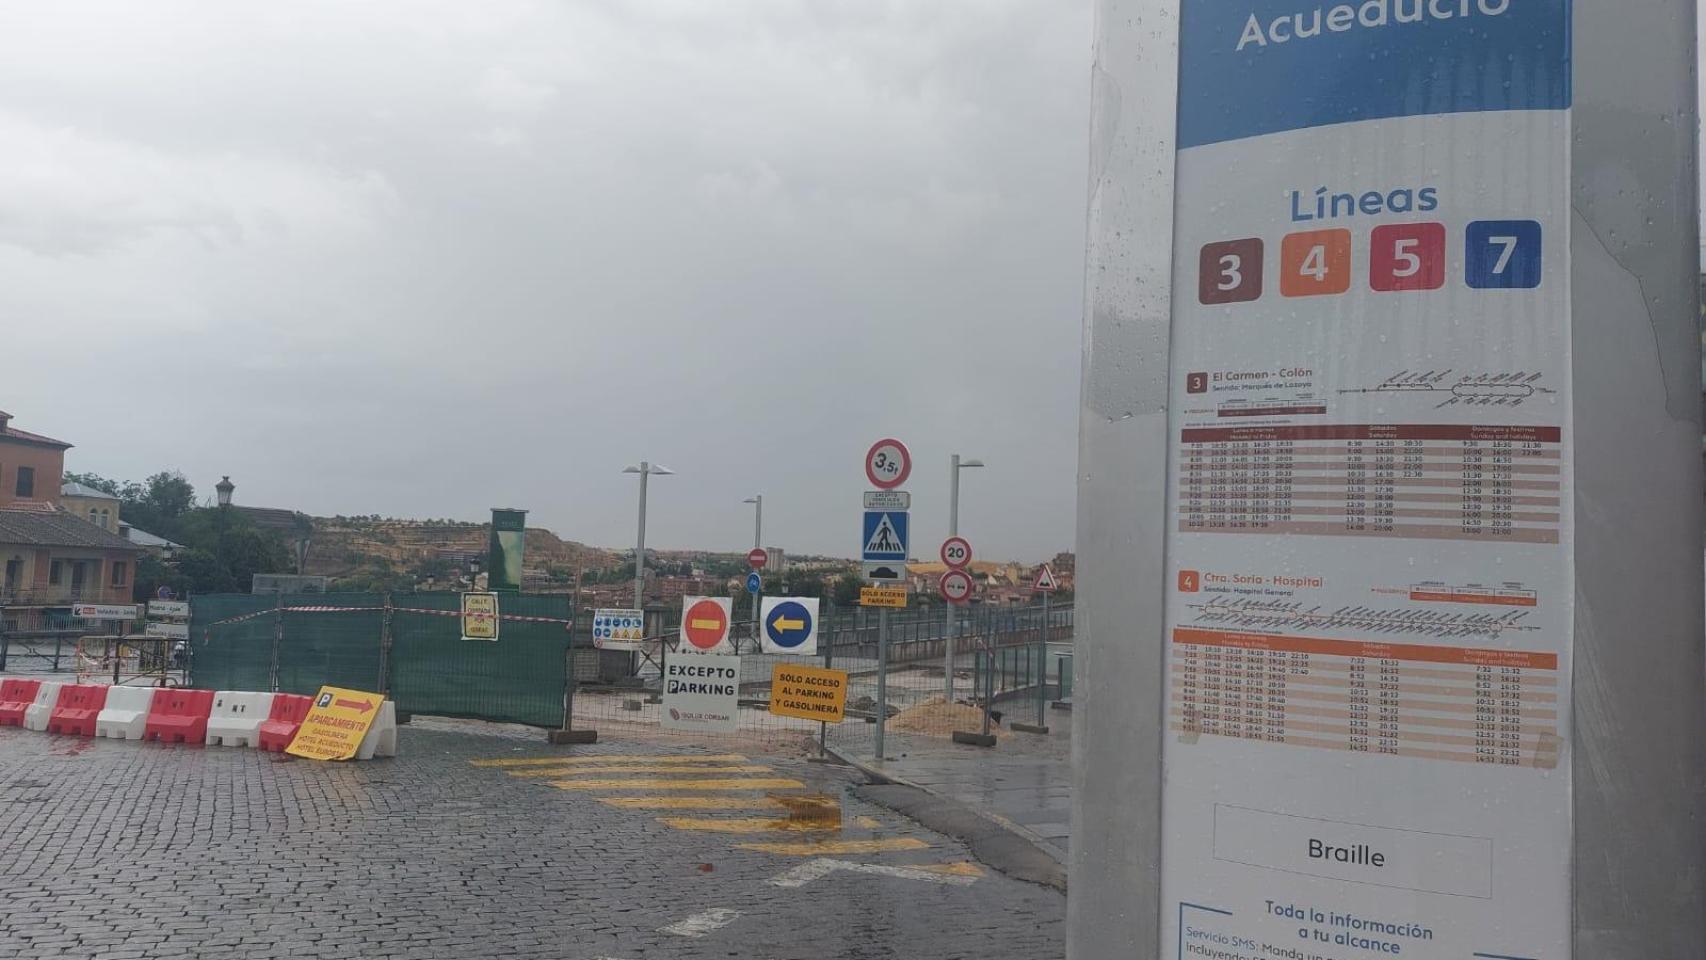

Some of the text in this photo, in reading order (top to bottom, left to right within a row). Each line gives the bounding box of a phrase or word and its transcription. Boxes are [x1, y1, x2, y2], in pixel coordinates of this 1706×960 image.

[1290, 185, 1439, 222] Líneas
[1217, 236, 1518, 291] 3 4 5 7
[1192, 376, 1202, 389] 3
[1213, 372, 1222, 381] El
[1225, 371, 1268, 380] Carmen
[1279, 367, 1312, 378] Colón
[1274, 382, 1284, 390] de
[948, 548, 964, 558] 20
[1184, 575, 1192, 587] 4
[1204, 572, 1229, 582] Ctra.
[1232, 574, 1262, 584] Soria
[1273, 575, 1323, 588] Hospital
[669, 665, 736, 679] EXCEPTO
[667, 680, 734, 696] PARKING
[805, 677, 840, 688] ACCESO
[318, 694, 330, 706] P
[782, 687, 834, 700] AL PARKING
[775, 698, 838, 714] Y GASOLINERA
[308, 714, 366, 732] APARCAMIENTO
[1308, 838, 1385, 868] Braille
[1265, 900, 1433, 940] Toda la información
[1186, 926, 1229, 945] Servicio
[1232, 936, 1258, 950] SMS:
[1262, 944, 1304, 960] Manda
[1298, 928, 1401, 954] a tu alcance
